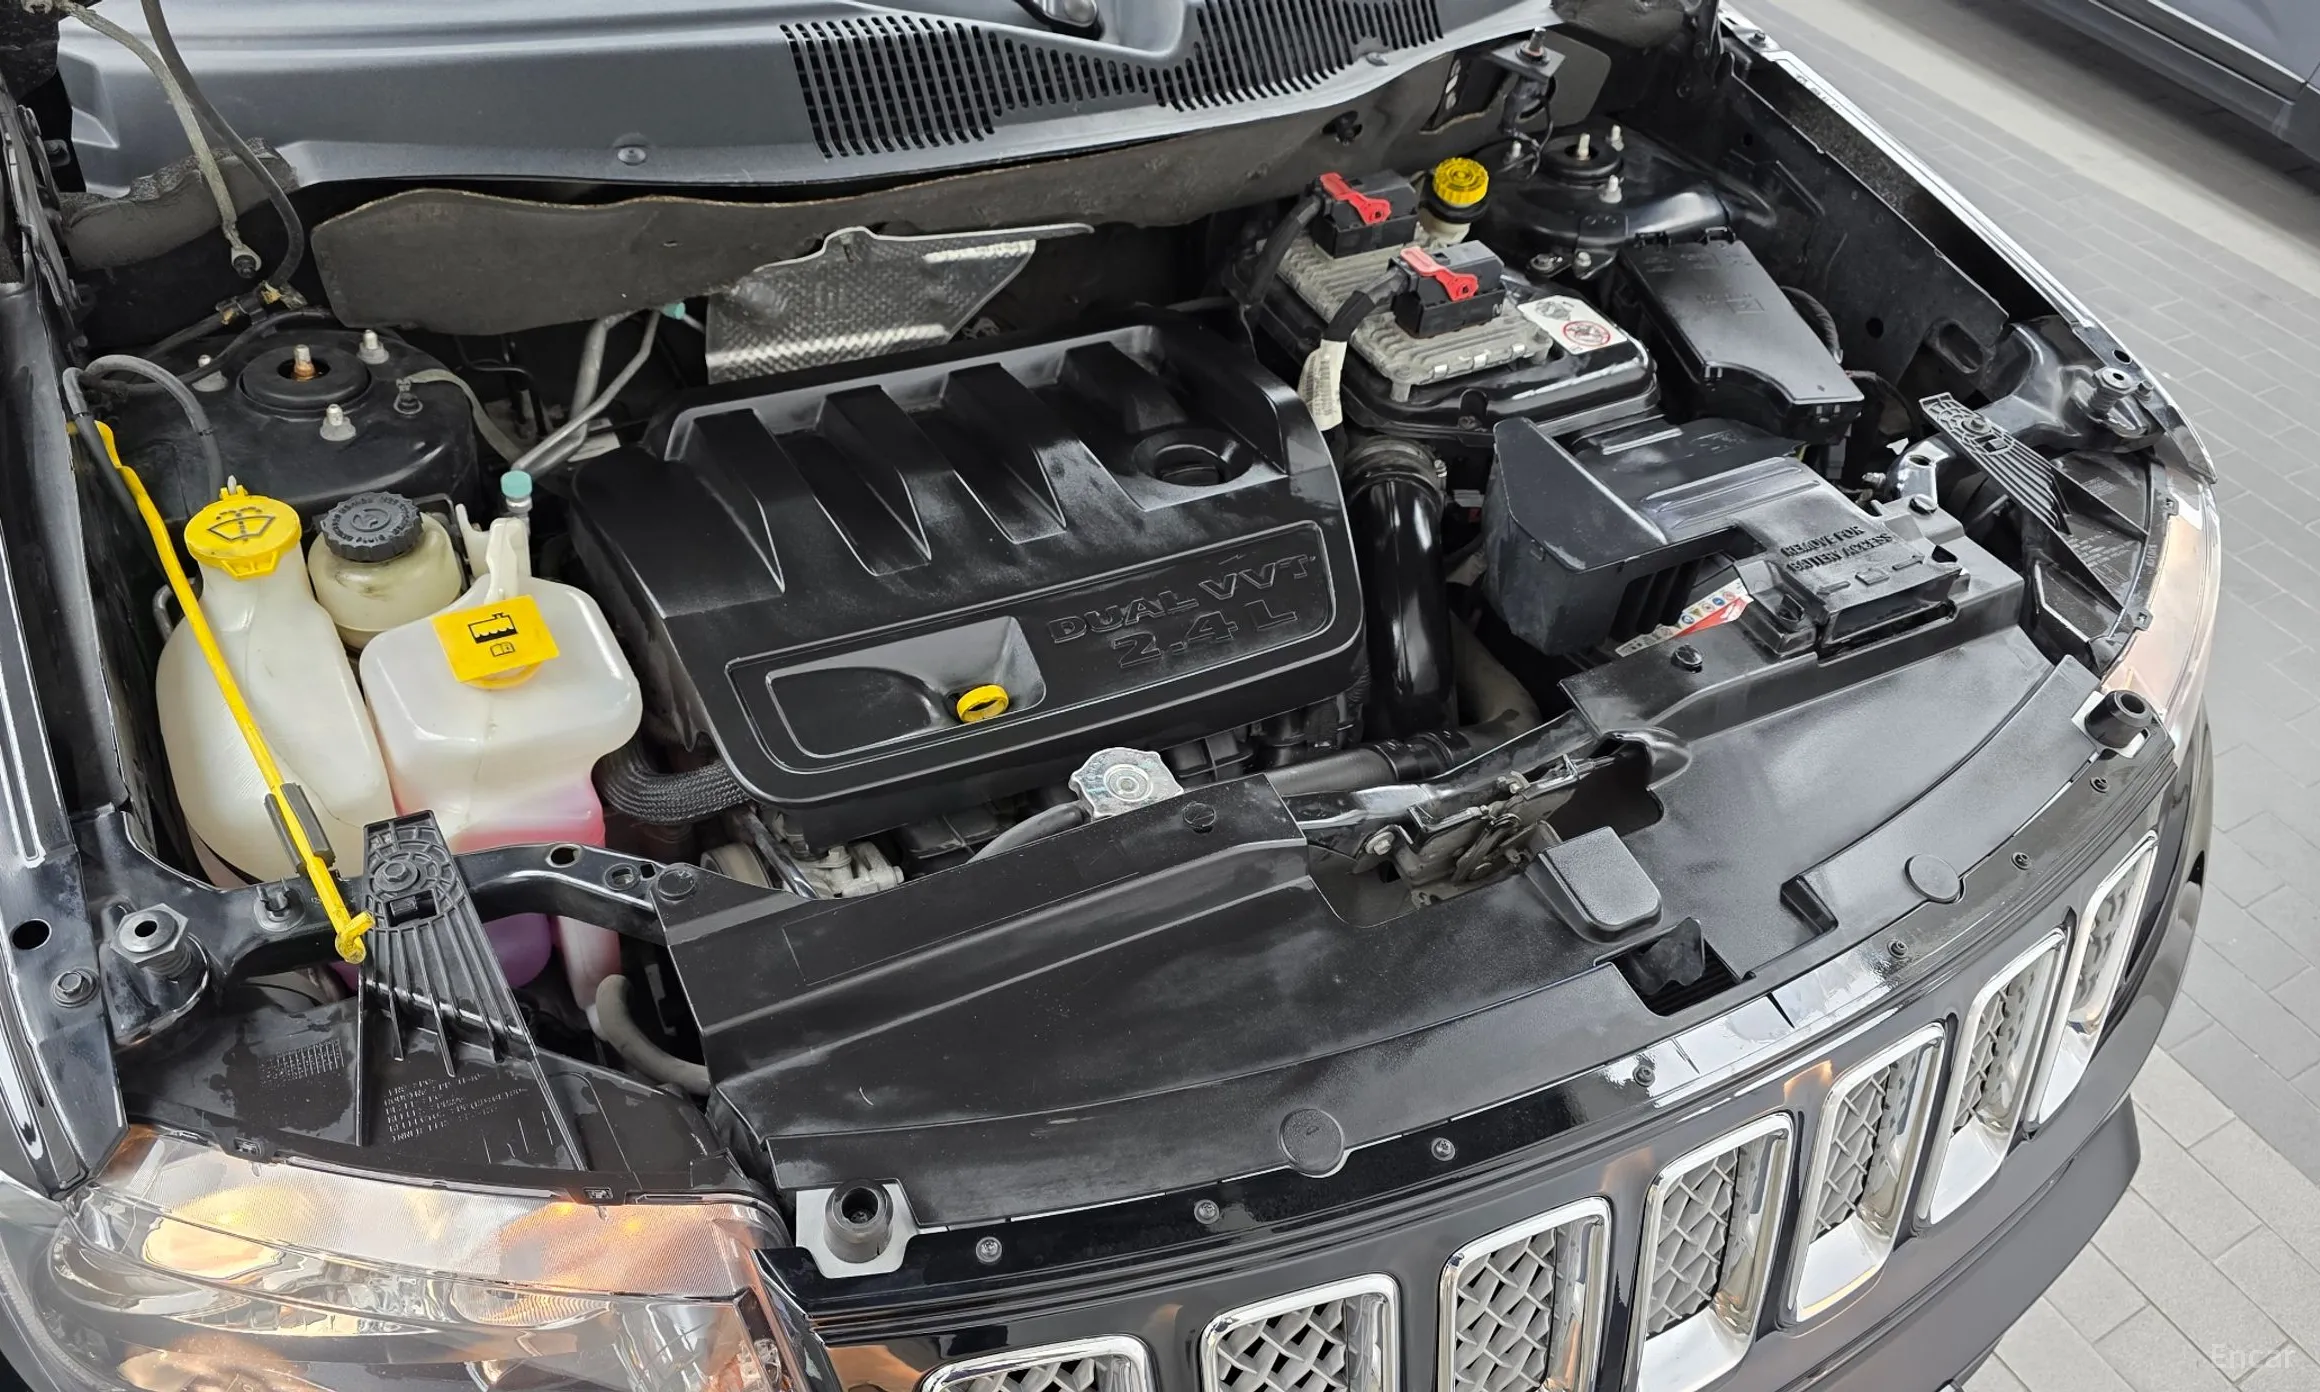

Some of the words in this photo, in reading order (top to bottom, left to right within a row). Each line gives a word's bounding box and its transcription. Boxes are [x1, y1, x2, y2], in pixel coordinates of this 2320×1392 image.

[1780, 535, 1838, 557] REMOVE
[1833, 526, 1865, 541] FOR
[1841, 533, 1893, 557] ACCESS
[1050, 590, 1199, 644] DUAL
[1199, 554, 1316, 600] VVT
[1110, 610, 1239, 668] 2.4
[1244, 599, 1298, 631] L
